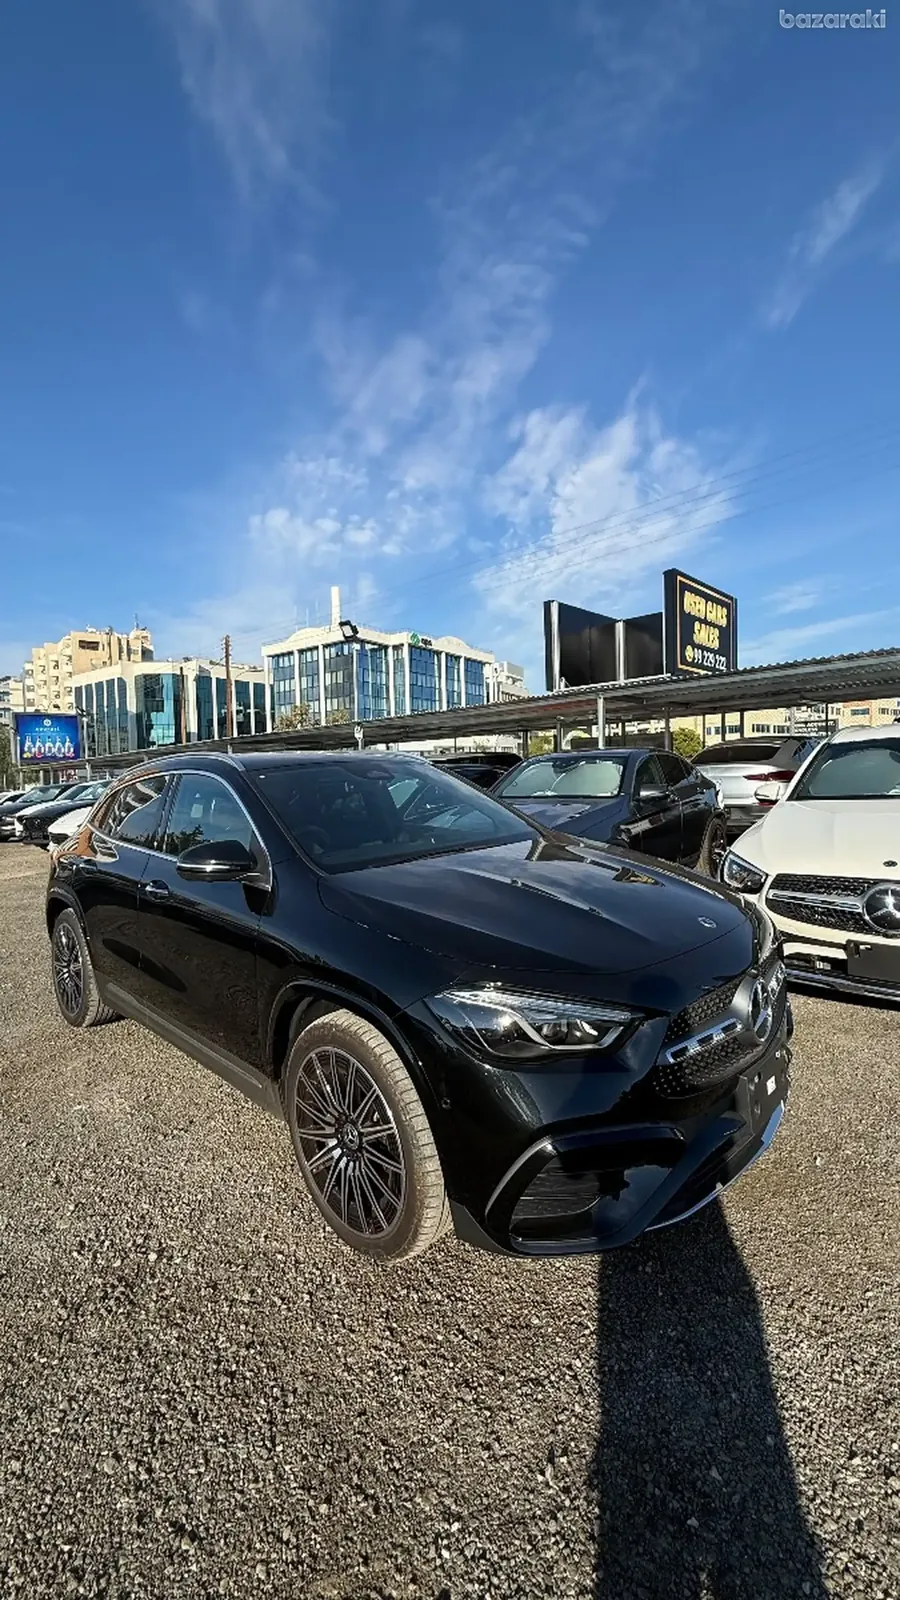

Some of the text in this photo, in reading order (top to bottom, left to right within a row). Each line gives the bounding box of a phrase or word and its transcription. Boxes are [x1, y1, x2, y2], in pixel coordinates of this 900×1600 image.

[684, 590, 727, 627] USED CARS
[694, 621, 719, 649] SALES
[694, 648, 702, 663] 99
[703, 650, 714, 667] 229
